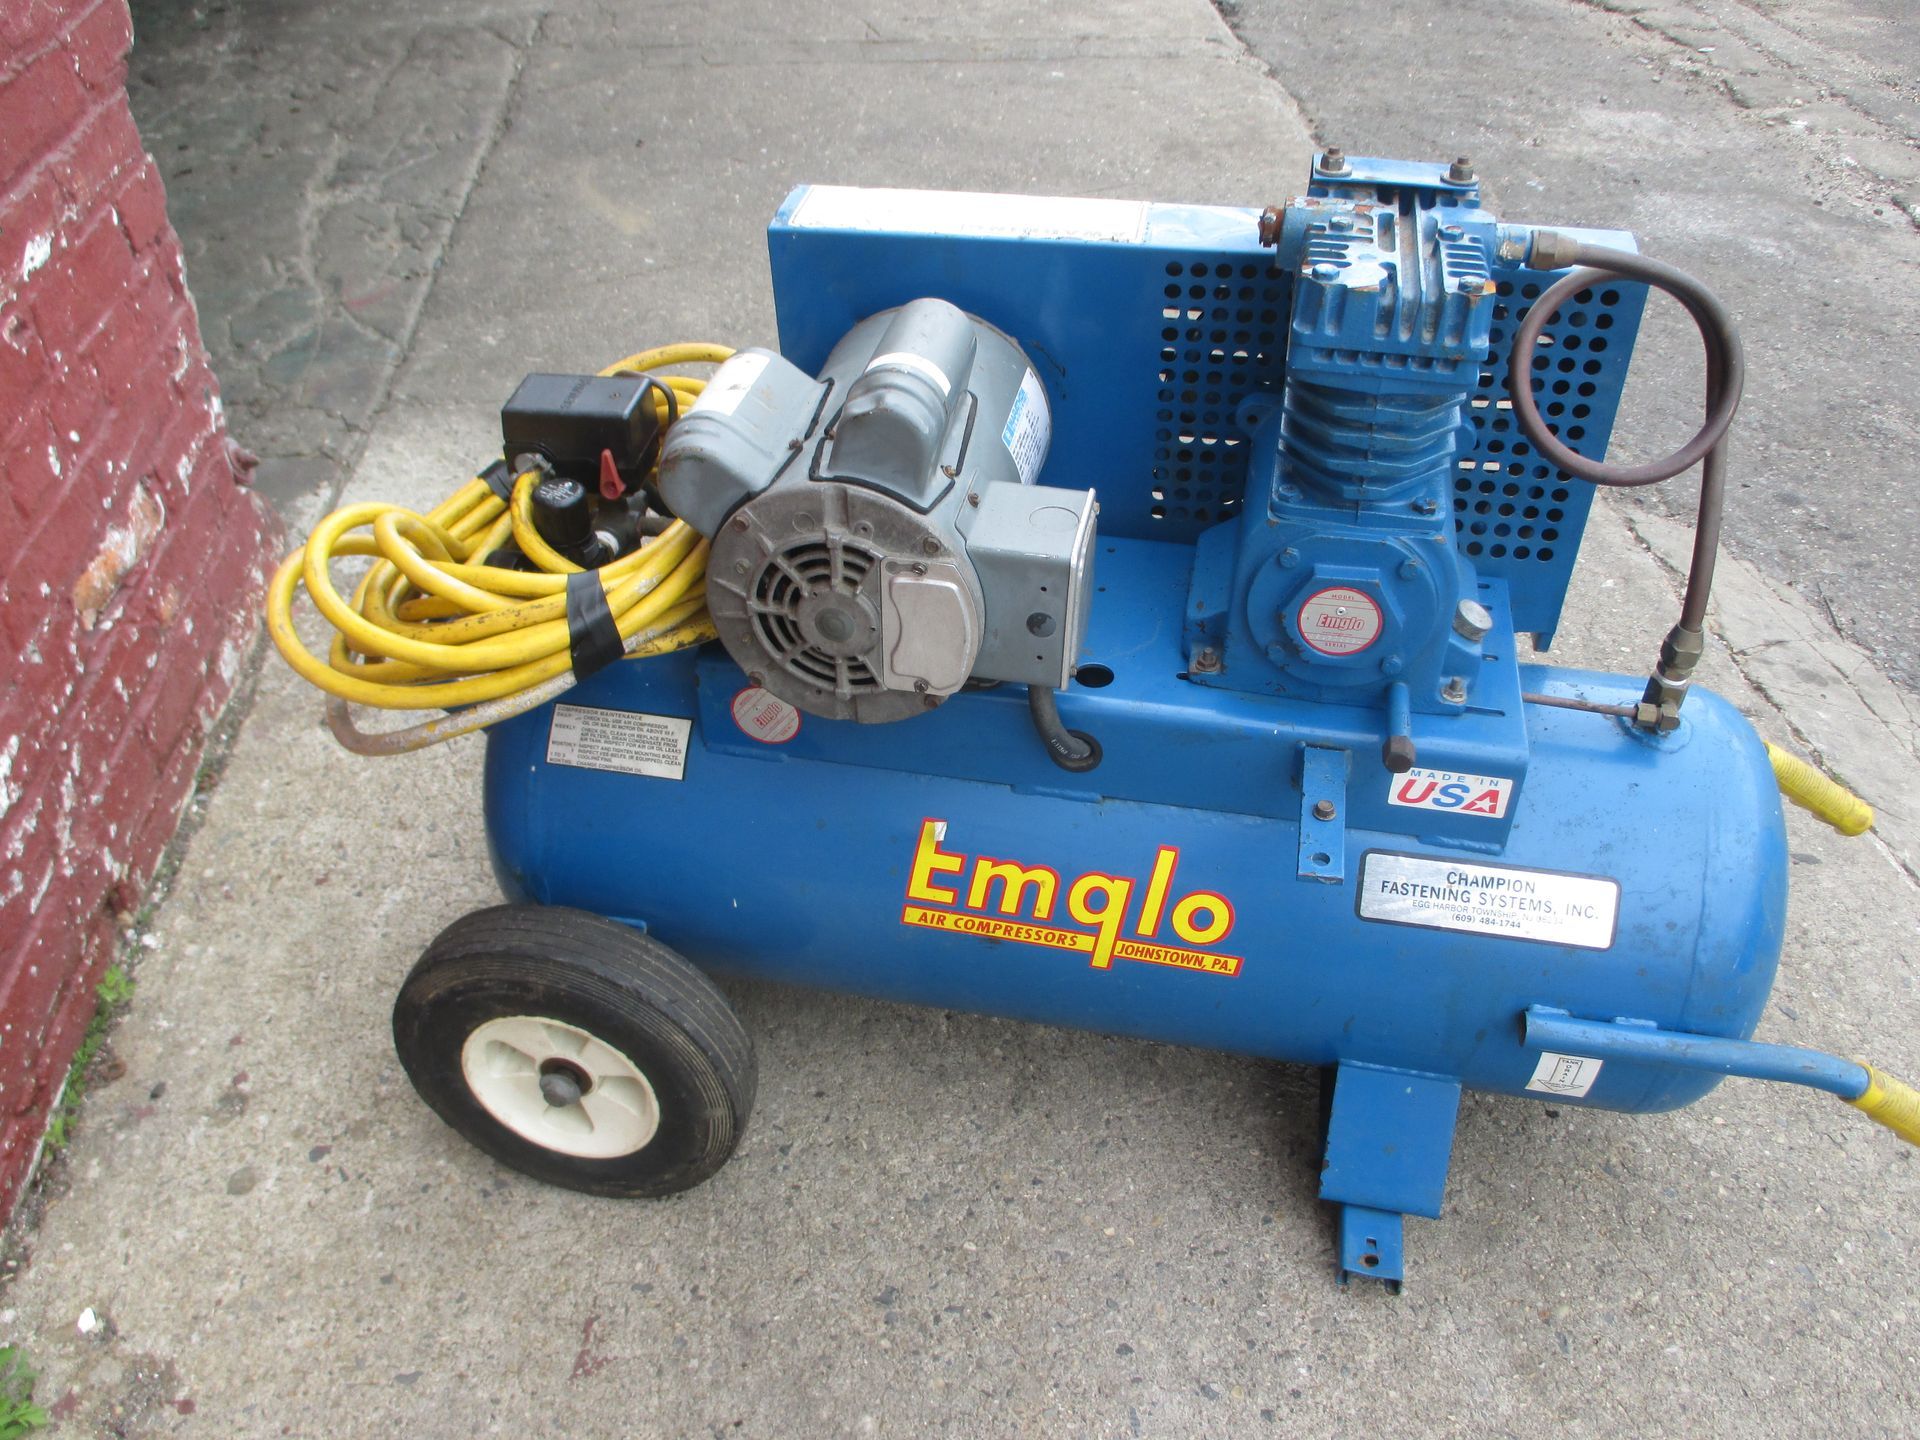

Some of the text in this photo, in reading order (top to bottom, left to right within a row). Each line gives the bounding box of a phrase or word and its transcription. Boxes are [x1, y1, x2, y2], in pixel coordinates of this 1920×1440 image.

[1316, 614, 1365, 631] Emglo
[558, 705, 642, 720] COMPRESSOR MAINTENANCE
[633, 720, 668, 729] COMPRESSOR
[628, 737, 661, 745] CONDENSATE
[598, 763, 633, 771] COMPRESSOR
[1410, 770, 1466, 782] MADE
[1397, 778, 1500, 814] USA
[1446, 871, 1536, 894] CHAMPION
[1382, 880, 1471, 903] FASTENING
[1566, 904, 1598, 920] INC.
[1412, 900, 1430, 908] EGG
[1433, 902, 1468, 913] HARBOR
[1452, 914, 1520, 928] (609) 484-1744
[918, 912, 1078, 947] AIR COMPRESSORS
[1117, 944, 1232, 972] JOHNSTOWN, PA.
